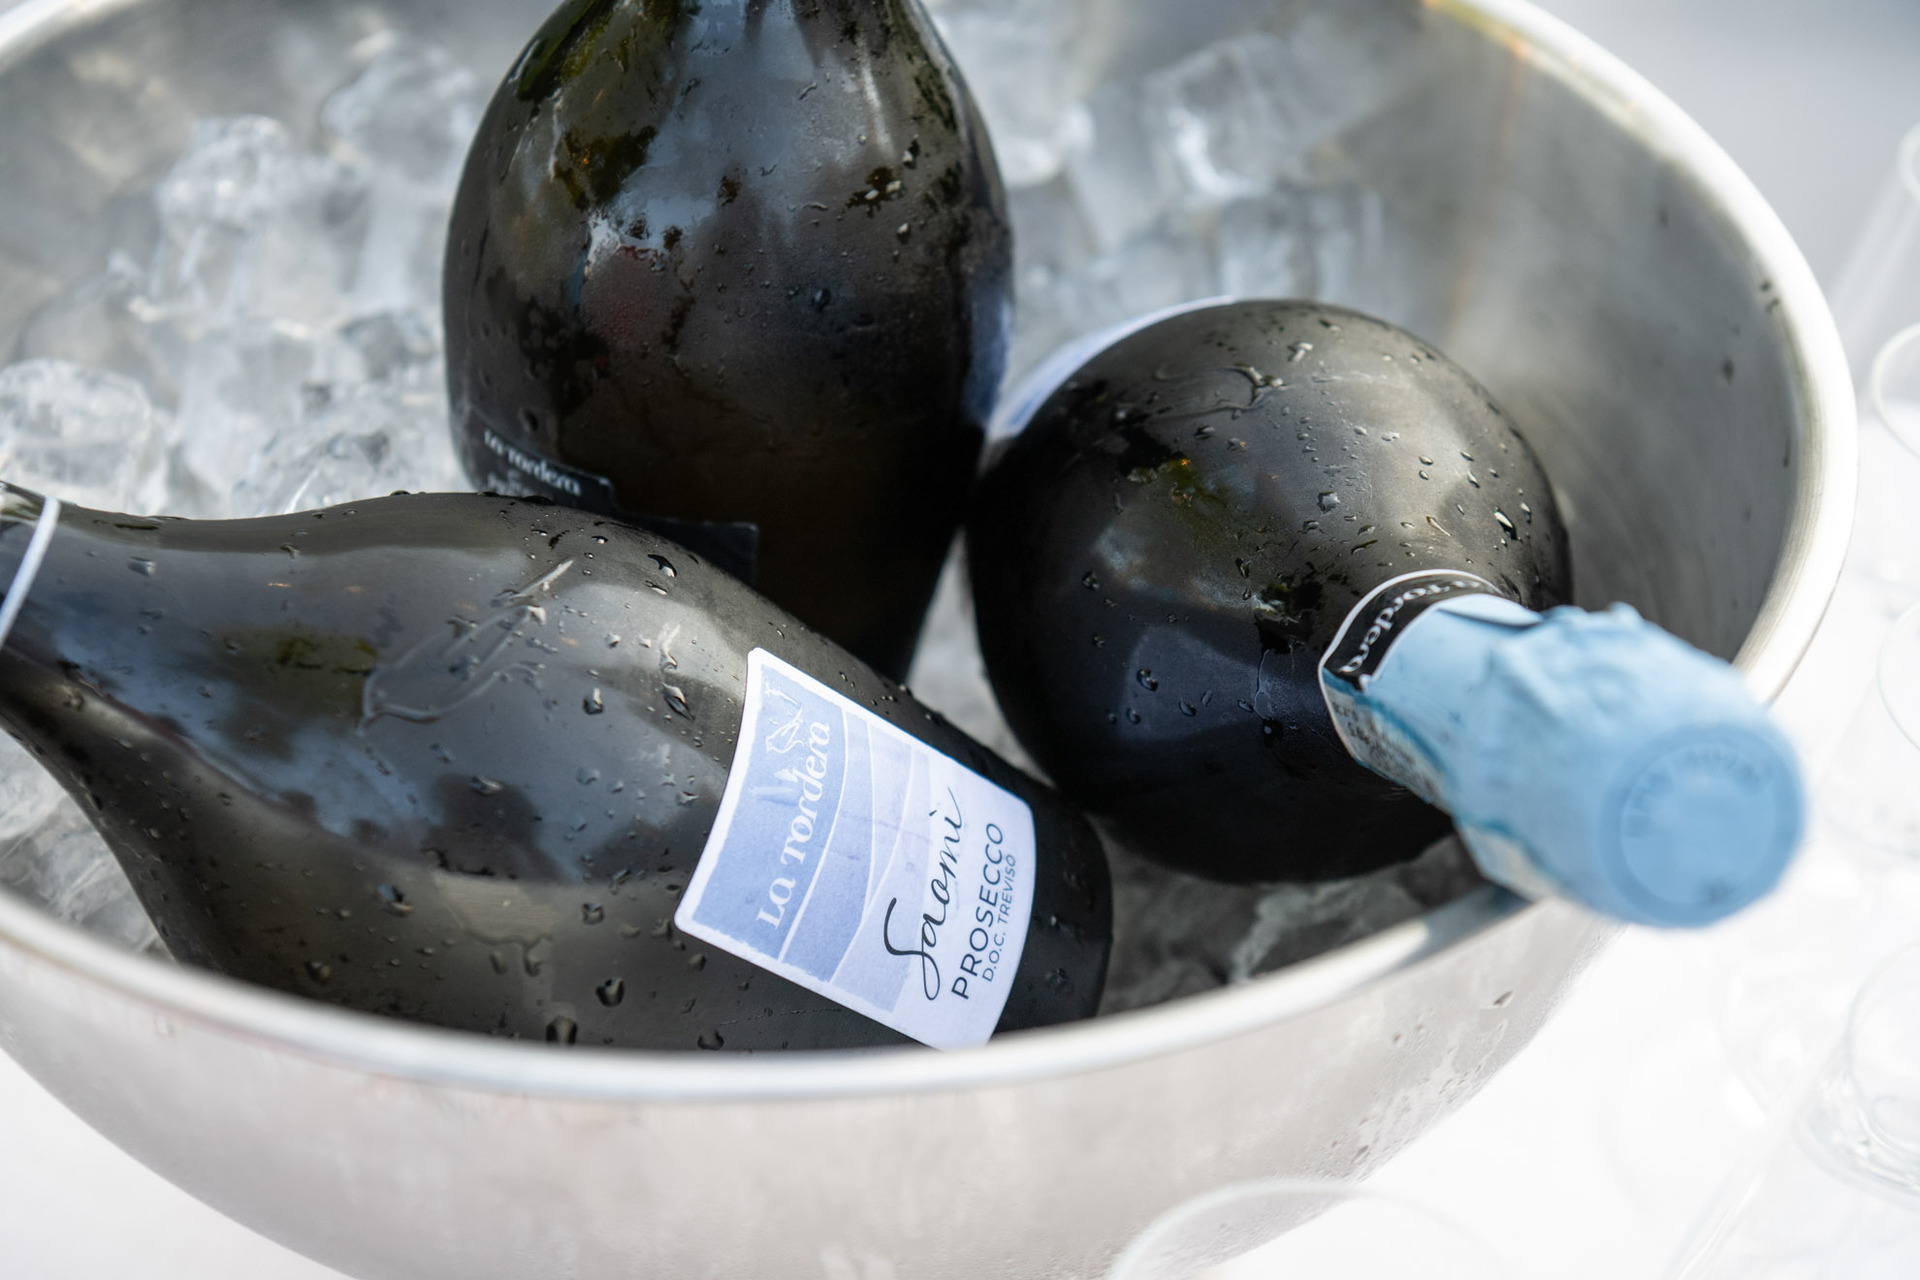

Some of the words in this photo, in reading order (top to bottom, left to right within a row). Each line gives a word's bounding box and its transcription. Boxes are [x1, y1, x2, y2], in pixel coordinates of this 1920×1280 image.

[952, 823, 1004, 999] PROSECCO
[982, 932, 1006, 982] D.O.C.
[997, 854, 1017, 924] TREVISO
